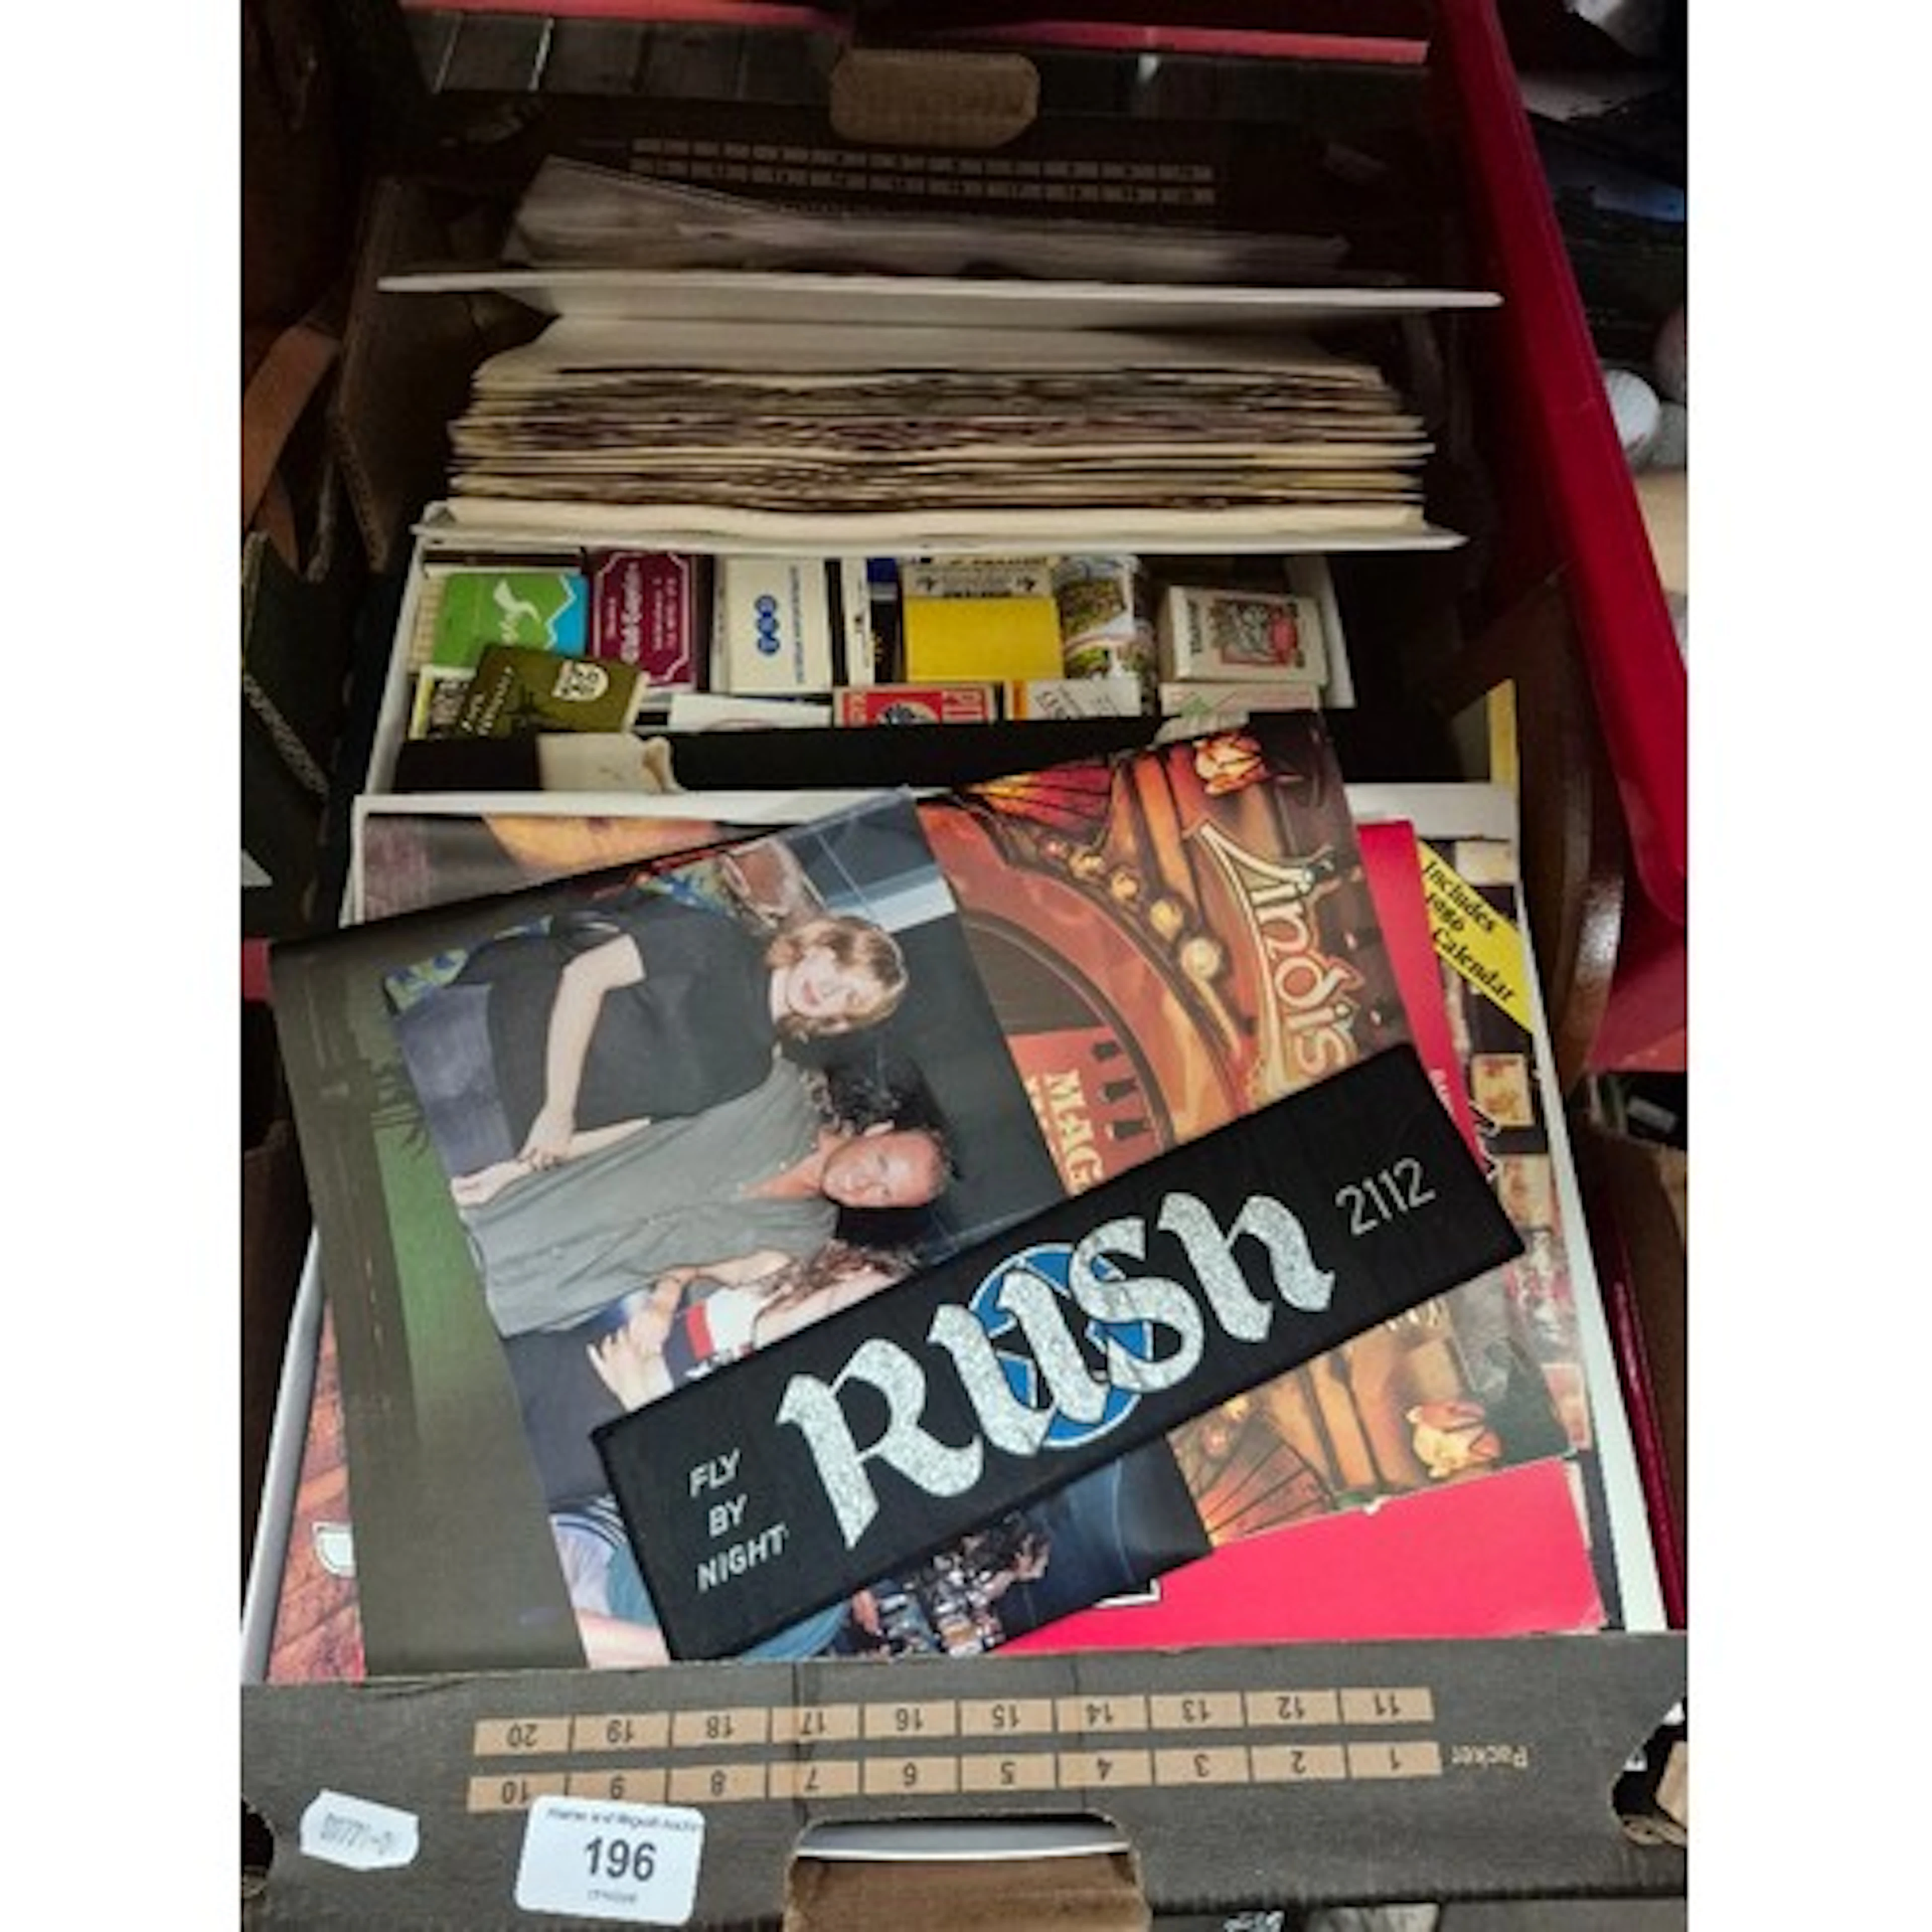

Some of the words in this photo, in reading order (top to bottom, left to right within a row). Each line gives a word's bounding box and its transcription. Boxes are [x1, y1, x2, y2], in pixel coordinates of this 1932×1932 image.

[1423, 861, 1493, 931] Includes
[1433, 927, 1513, 1001] Calendar
[1334, 1157, 1436, 1238] 2112
[689, 1447, 742, 1498] FLY
[709, 1493, 748, 1538] BY
[697, 1521, 790, 1594] NIGHT
[992, 1704, 1020, 1728] 15
[1086, 1703, 1113, 1726] 14
[1181, 1699, 1211, 1723] 13
[1277, 1696, 1305, 1721] 12
[1374, 1692, 1401, 1717] 11
[607, 1719, 635, 1742] 19
[706, 1714, 735, 1739] 18
[801, 1710, 826, 1735] 17
[896, 1708, 924, 1732] 16
[507, 1723, 538, 1747] 20
[1097, 1758, 1113, 1780] 4
[1193, 1754, 1210, 1778] 3
[1291, 1750, 1308, 1775] 2
[1389, 1748, 1401, 1770] 1
[1451, 1744, 1529, 1769] Packer
[710, 1770, 727, 1796] 8
[806, 1765, 821, 1790] 7
[902, 1762, 917, 1786] 6
[1000, 1762, 1016, 1785] 5
[501, 1781, 528, 1804] 10
[609, 1775, 626, 1800] 9
[585, 1835, 657, 1882] 196
